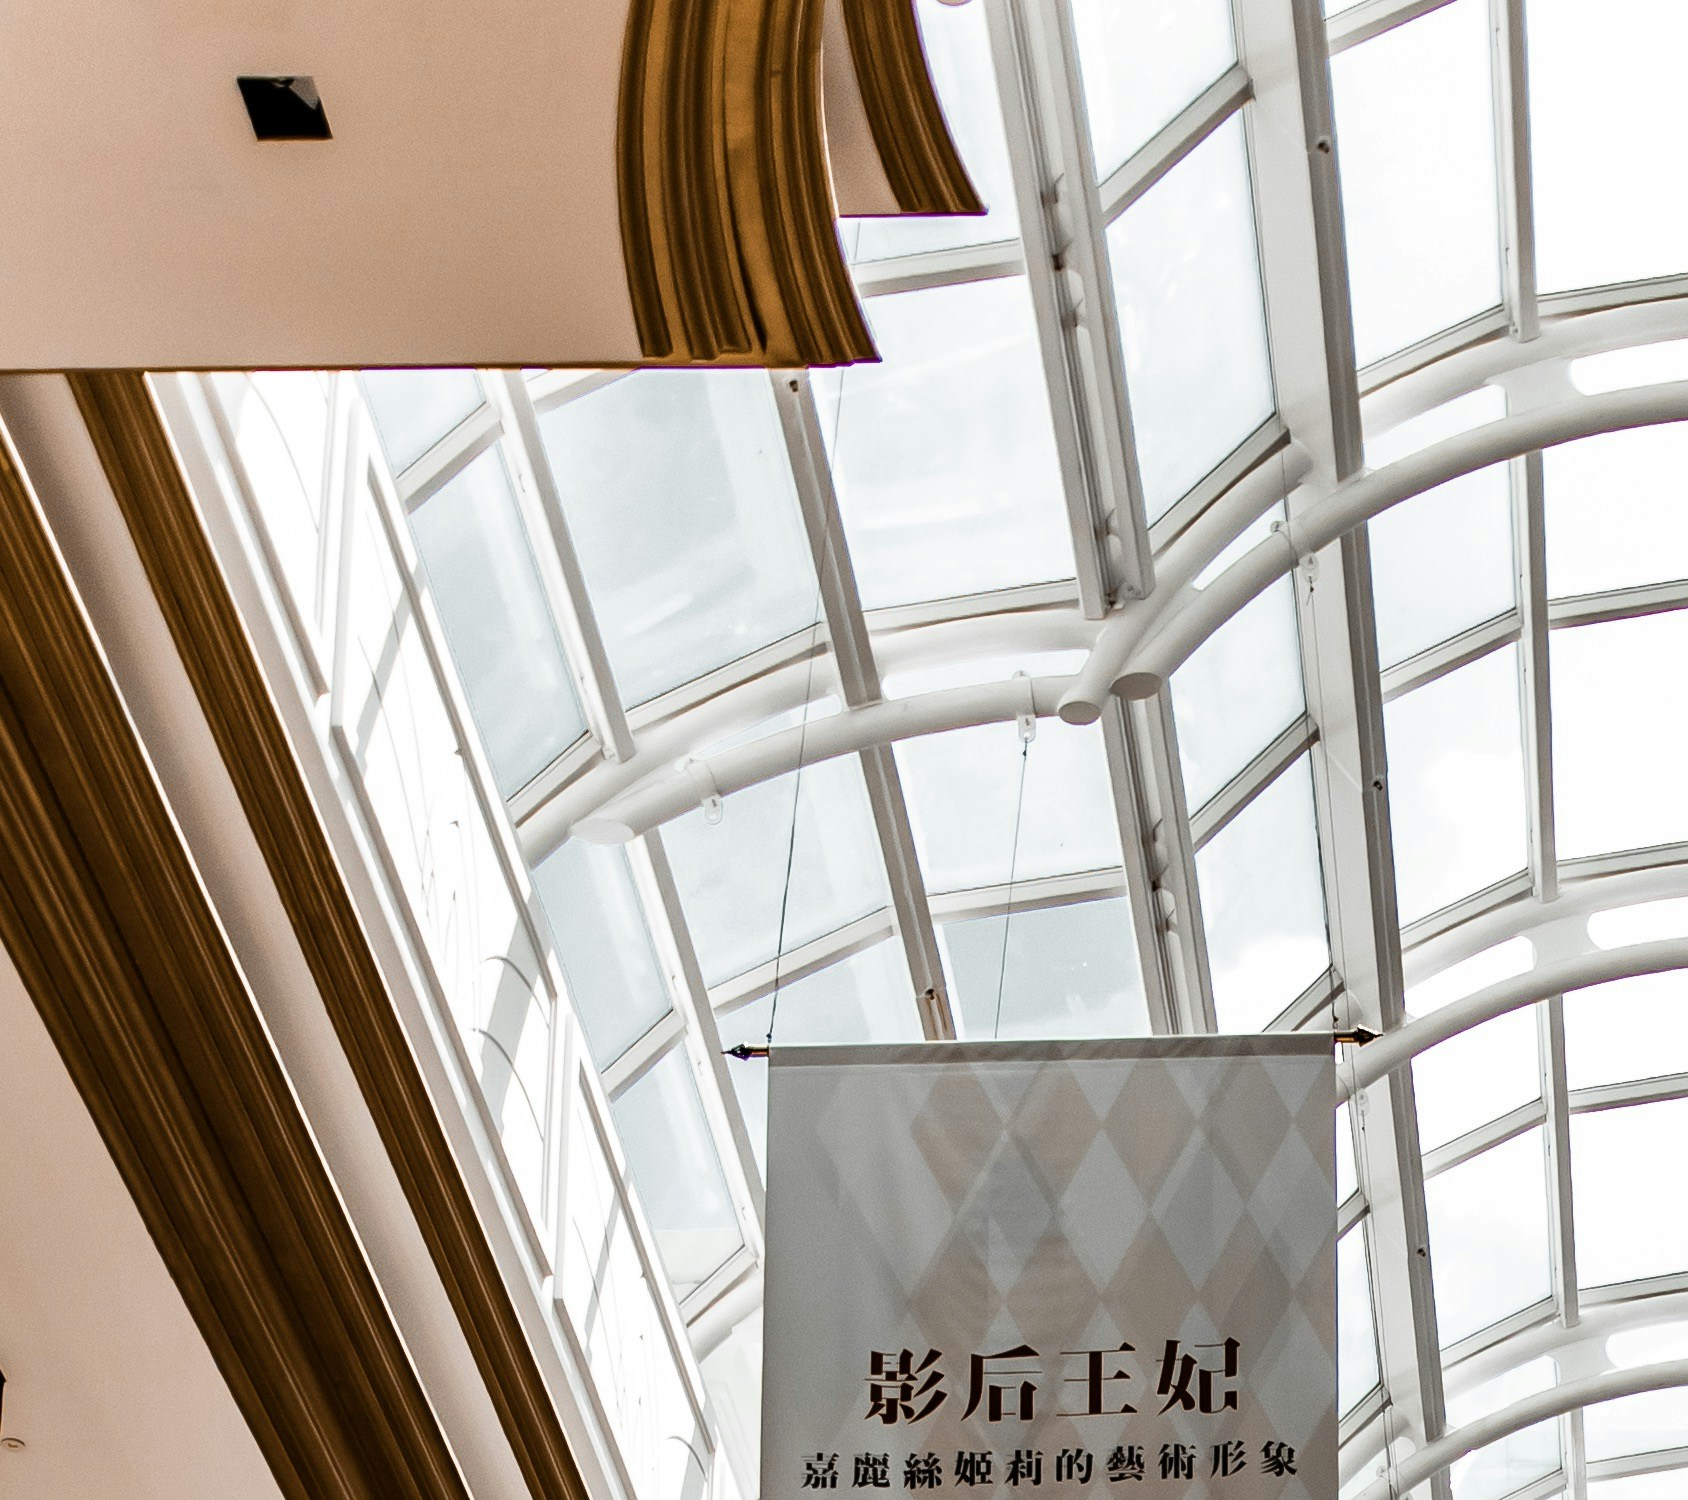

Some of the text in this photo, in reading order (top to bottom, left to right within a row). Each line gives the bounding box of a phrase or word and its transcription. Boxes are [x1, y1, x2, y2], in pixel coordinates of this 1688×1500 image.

[864, 1336, 1240, 1425] 影后王妃
[801, 1440, 1298, 1490] 嘉麗絲姬莉的藝術形象
